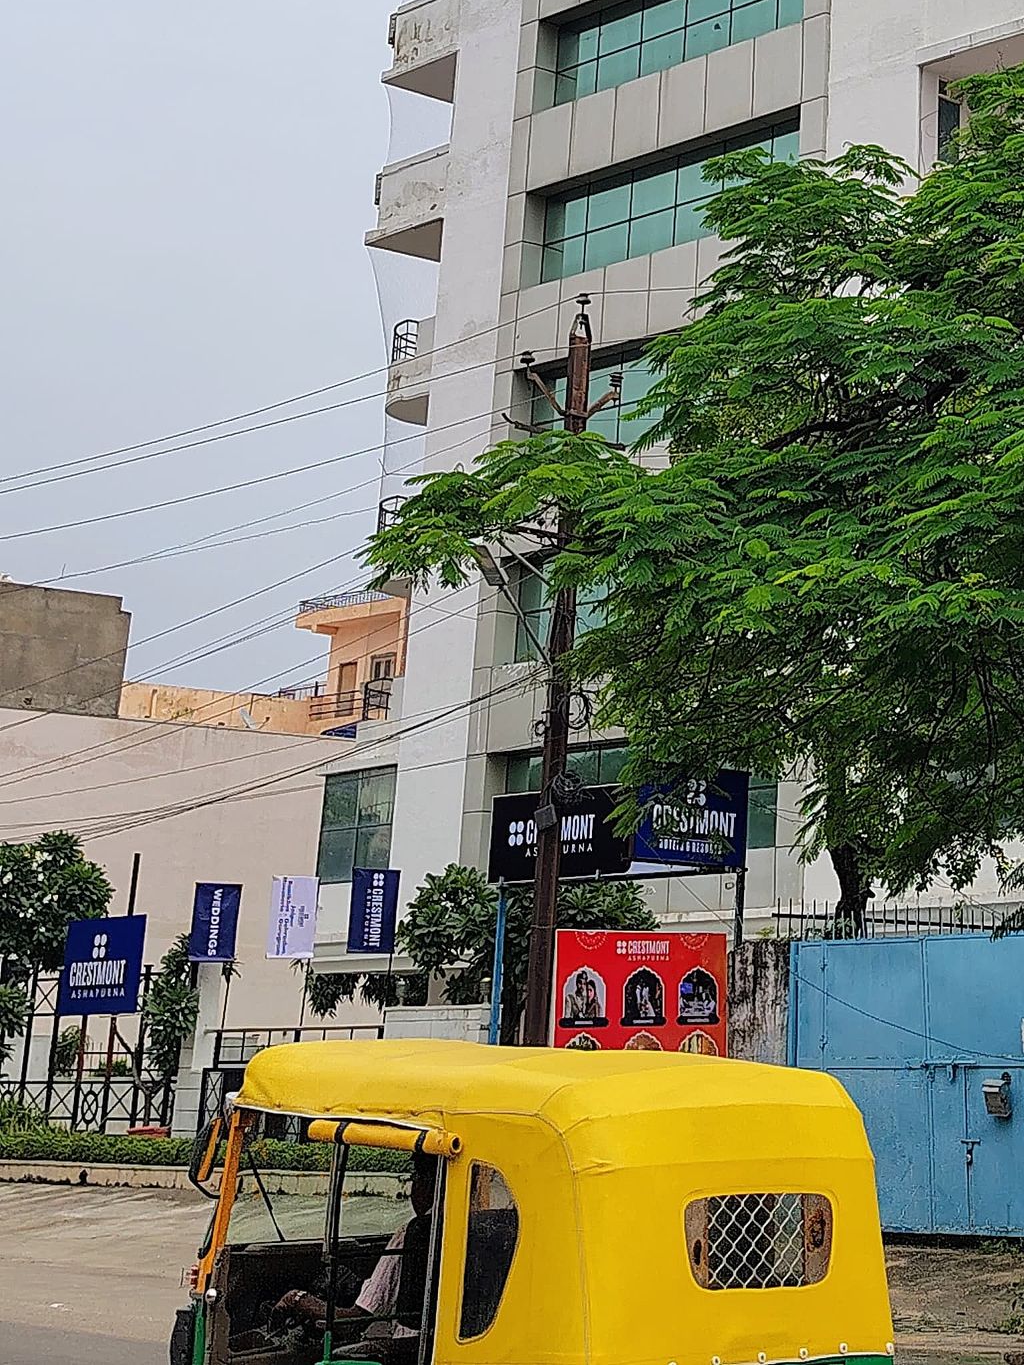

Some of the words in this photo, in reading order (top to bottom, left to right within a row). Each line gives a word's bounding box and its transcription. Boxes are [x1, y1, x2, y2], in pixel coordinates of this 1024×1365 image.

[525, 814, 596, 845] CMONT
[525, 842, 593, 858] ASURNA
[207, 888, 223, 957] WEDDINGS
[368, 888, 384, 948] CRESTMONT
[627, 940, 670, 955] CRESTMONT
[69, 959, 127, 987] CRESTMONT
[70, 987, 125, 999] ASHAPURNA
